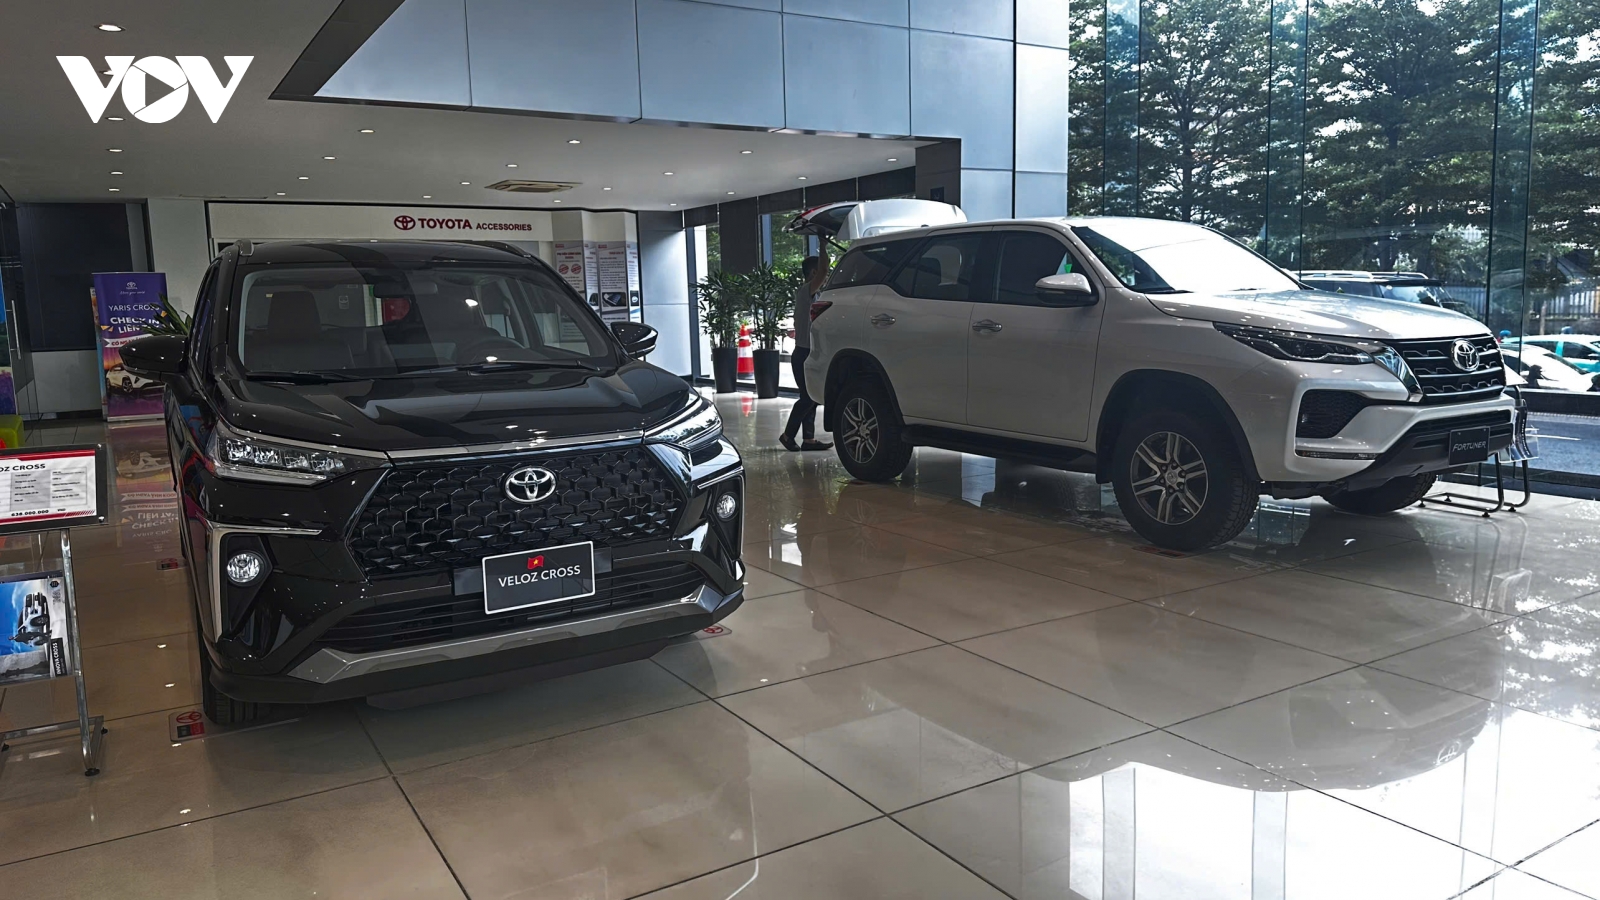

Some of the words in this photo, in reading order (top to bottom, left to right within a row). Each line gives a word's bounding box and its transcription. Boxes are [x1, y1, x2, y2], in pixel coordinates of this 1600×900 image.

[418, 218, 473, 230] TOYOTA
[475, 222, 533, 231] ACCESSORIES
[1452, 441, 1487, 452] FORTUNER
[12, 463, 46, 471] CROSS
[498, 572, 538, 588] VELOZ
[540, 564, 581, 581] CROSS
